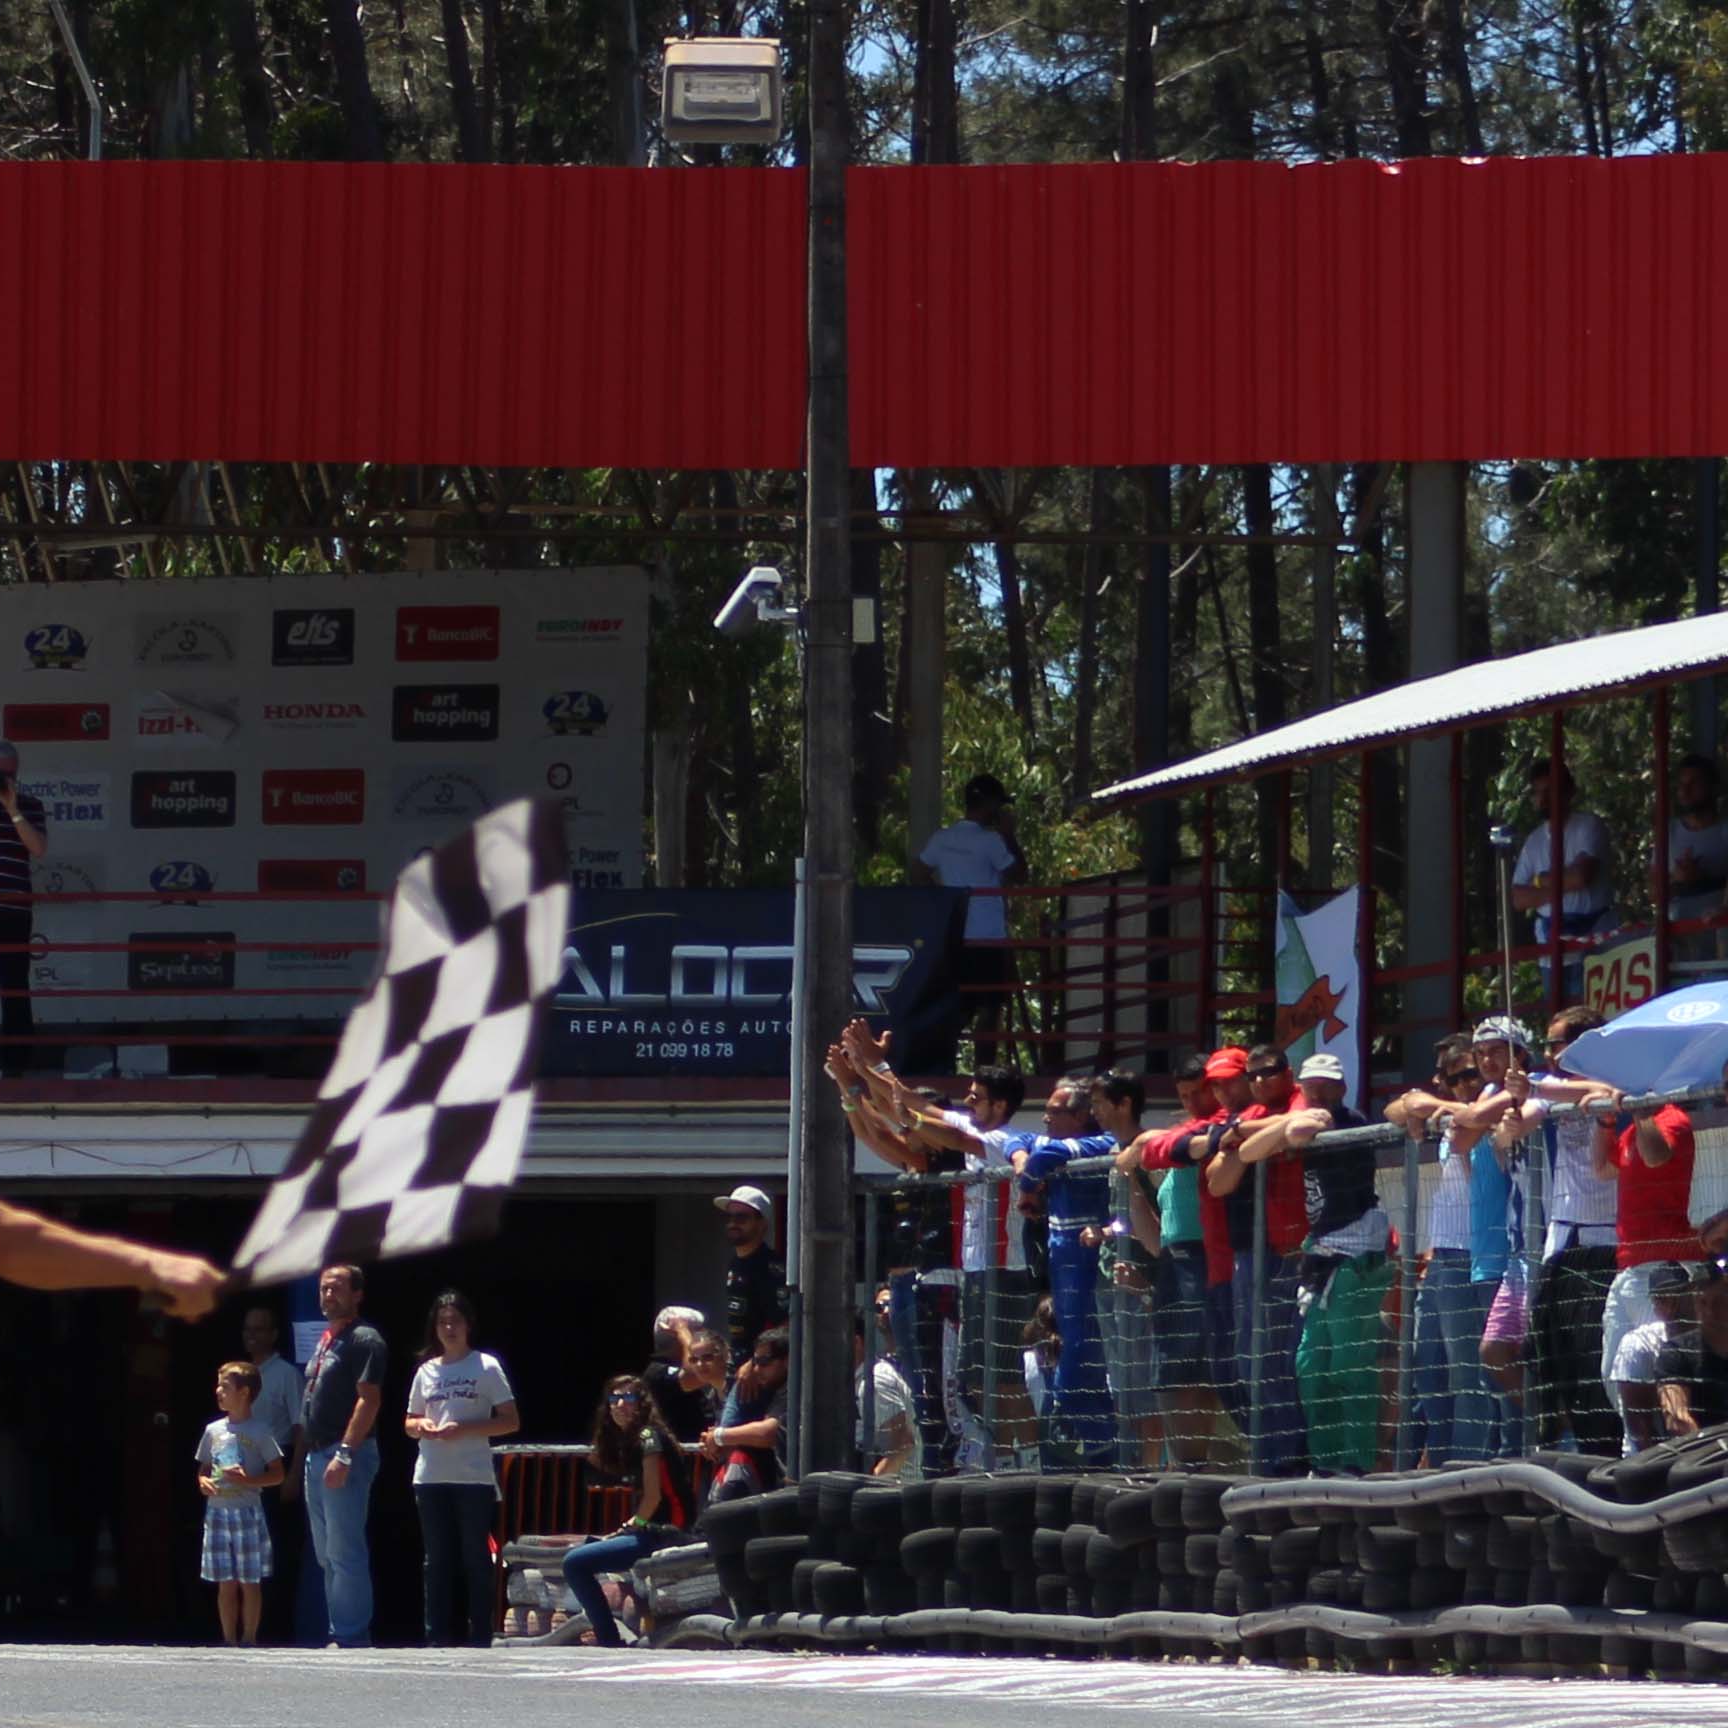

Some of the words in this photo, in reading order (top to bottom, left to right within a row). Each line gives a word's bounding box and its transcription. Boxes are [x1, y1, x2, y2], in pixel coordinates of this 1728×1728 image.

[32, 627, 72, 652] 24
[263, 703, 367, 719] HONDA
[17, 780, 58, 797] lectric
[60, 781, 101, 797] Power
[1585, 951, 1653, 1014] GAS
[569, 1015, 727, 1037] REPARAÇÕES
[635, 1042, 654, 1058] 21
[659, 1042, 688, 1058] 099
[692, 1042, 711, 1058] 18
[714, 1042, 735, 1058] 78
